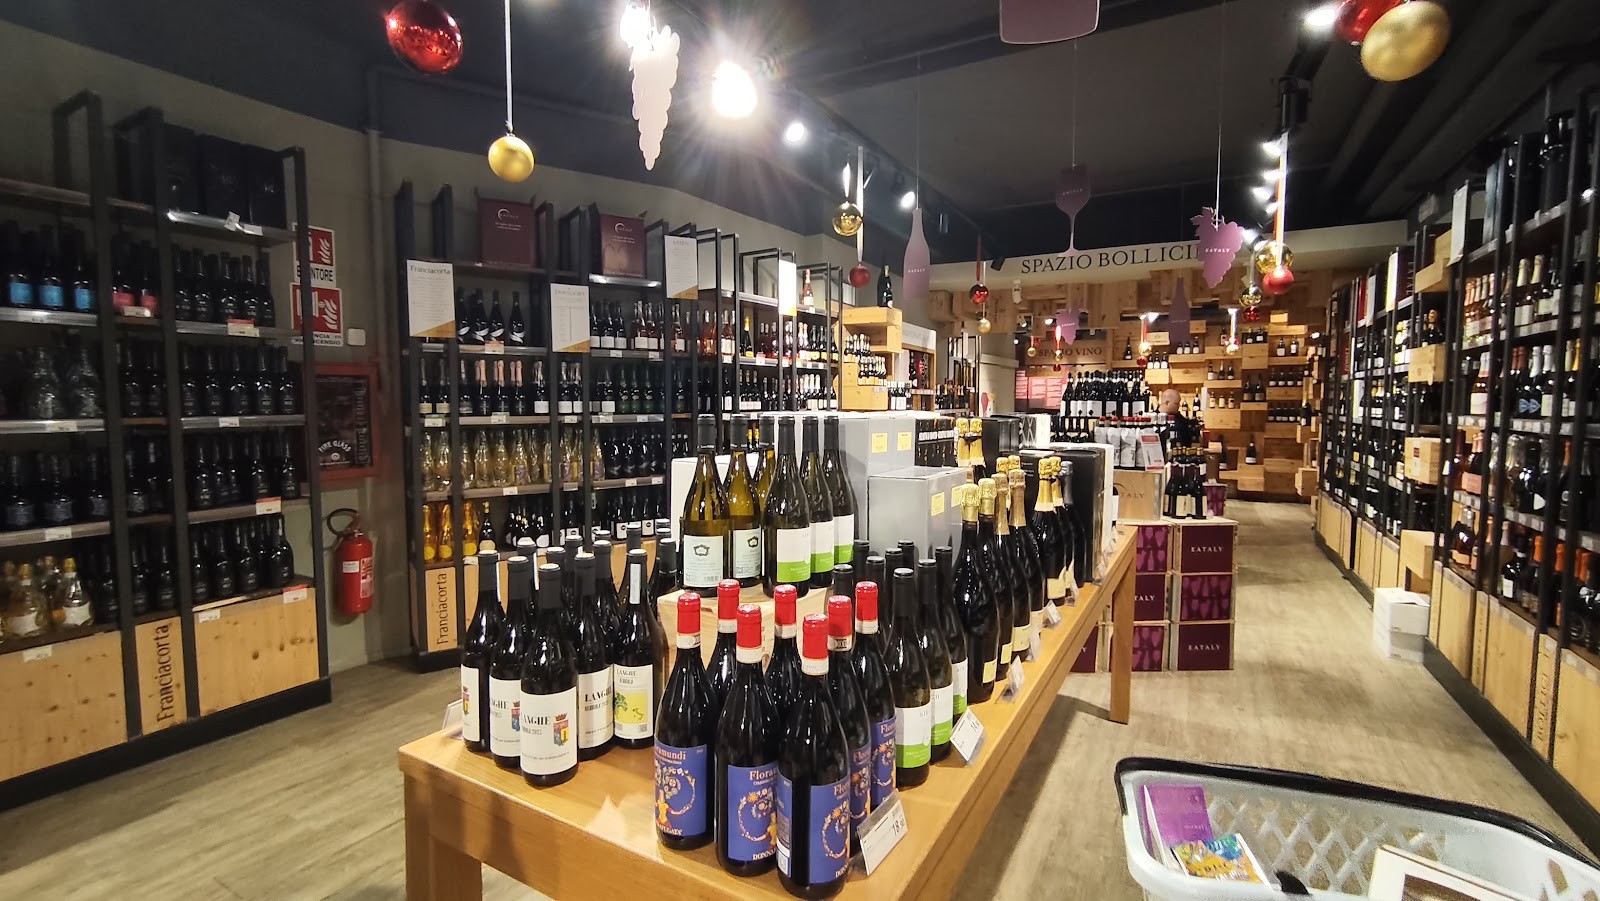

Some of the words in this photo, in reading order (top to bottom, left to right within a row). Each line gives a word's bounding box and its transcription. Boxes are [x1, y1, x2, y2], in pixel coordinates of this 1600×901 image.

[410, 264, 451, 275] Franciacorta
[1021, 253, 1092, 274] SPAZIO
[297, 264, 334, 282] ENTORE
[1038, 348, 1073, 357] SPAIO
[1076, 346, 1103, 356] VINO
[332, 440, 351, 452] GLASS
[436, 573, 449, 645] Franciacorta
[154, 624, 175, 722] Franciacorta
[521, 713, 551, 726] ANGHE
